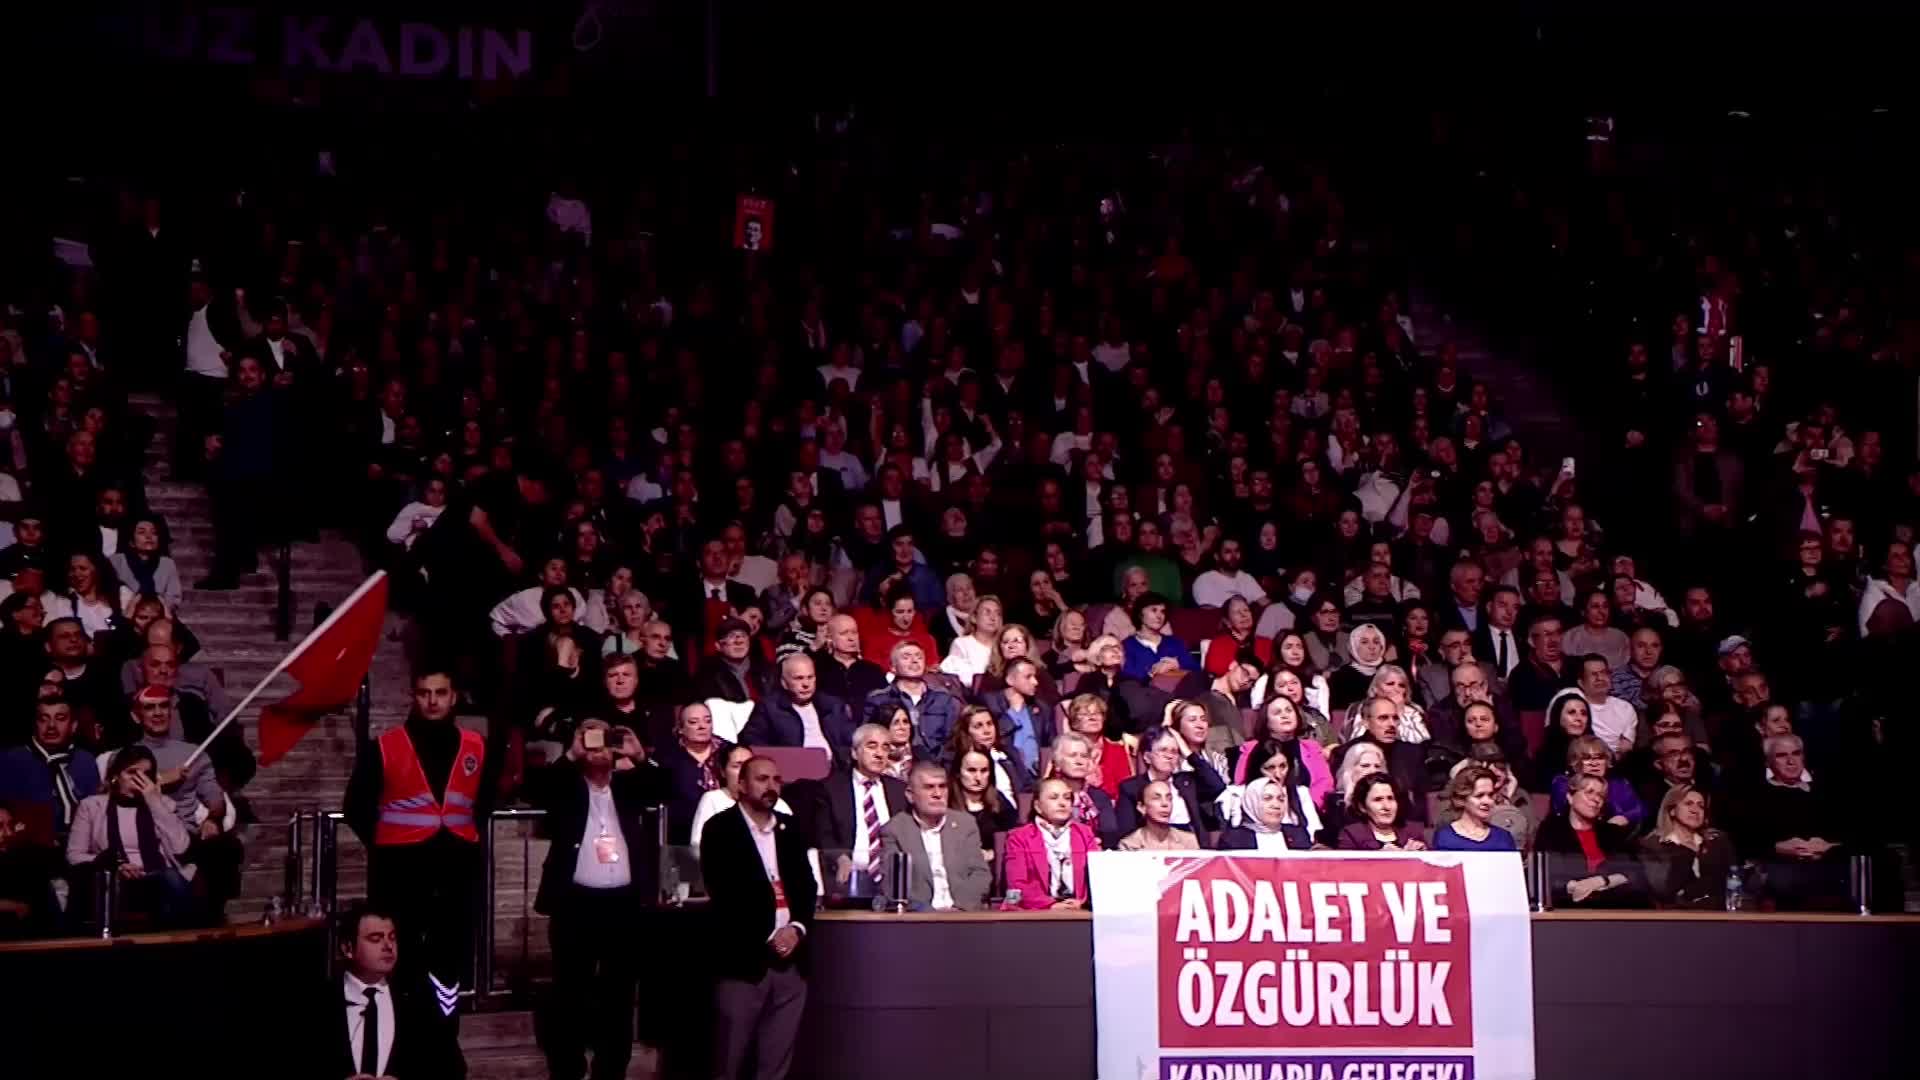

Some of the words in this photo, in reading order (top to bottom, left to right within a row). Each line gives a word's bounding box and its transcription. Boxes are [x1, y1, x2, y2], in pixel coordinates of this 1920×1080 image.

[283, 15, 533, 79] KADIN
[1176, 879, 1369, 943] ADALET
[1381, 881, 1452, 943] VE
[1177, 947, 1454, 1027] ÖZGÜRLÜK
